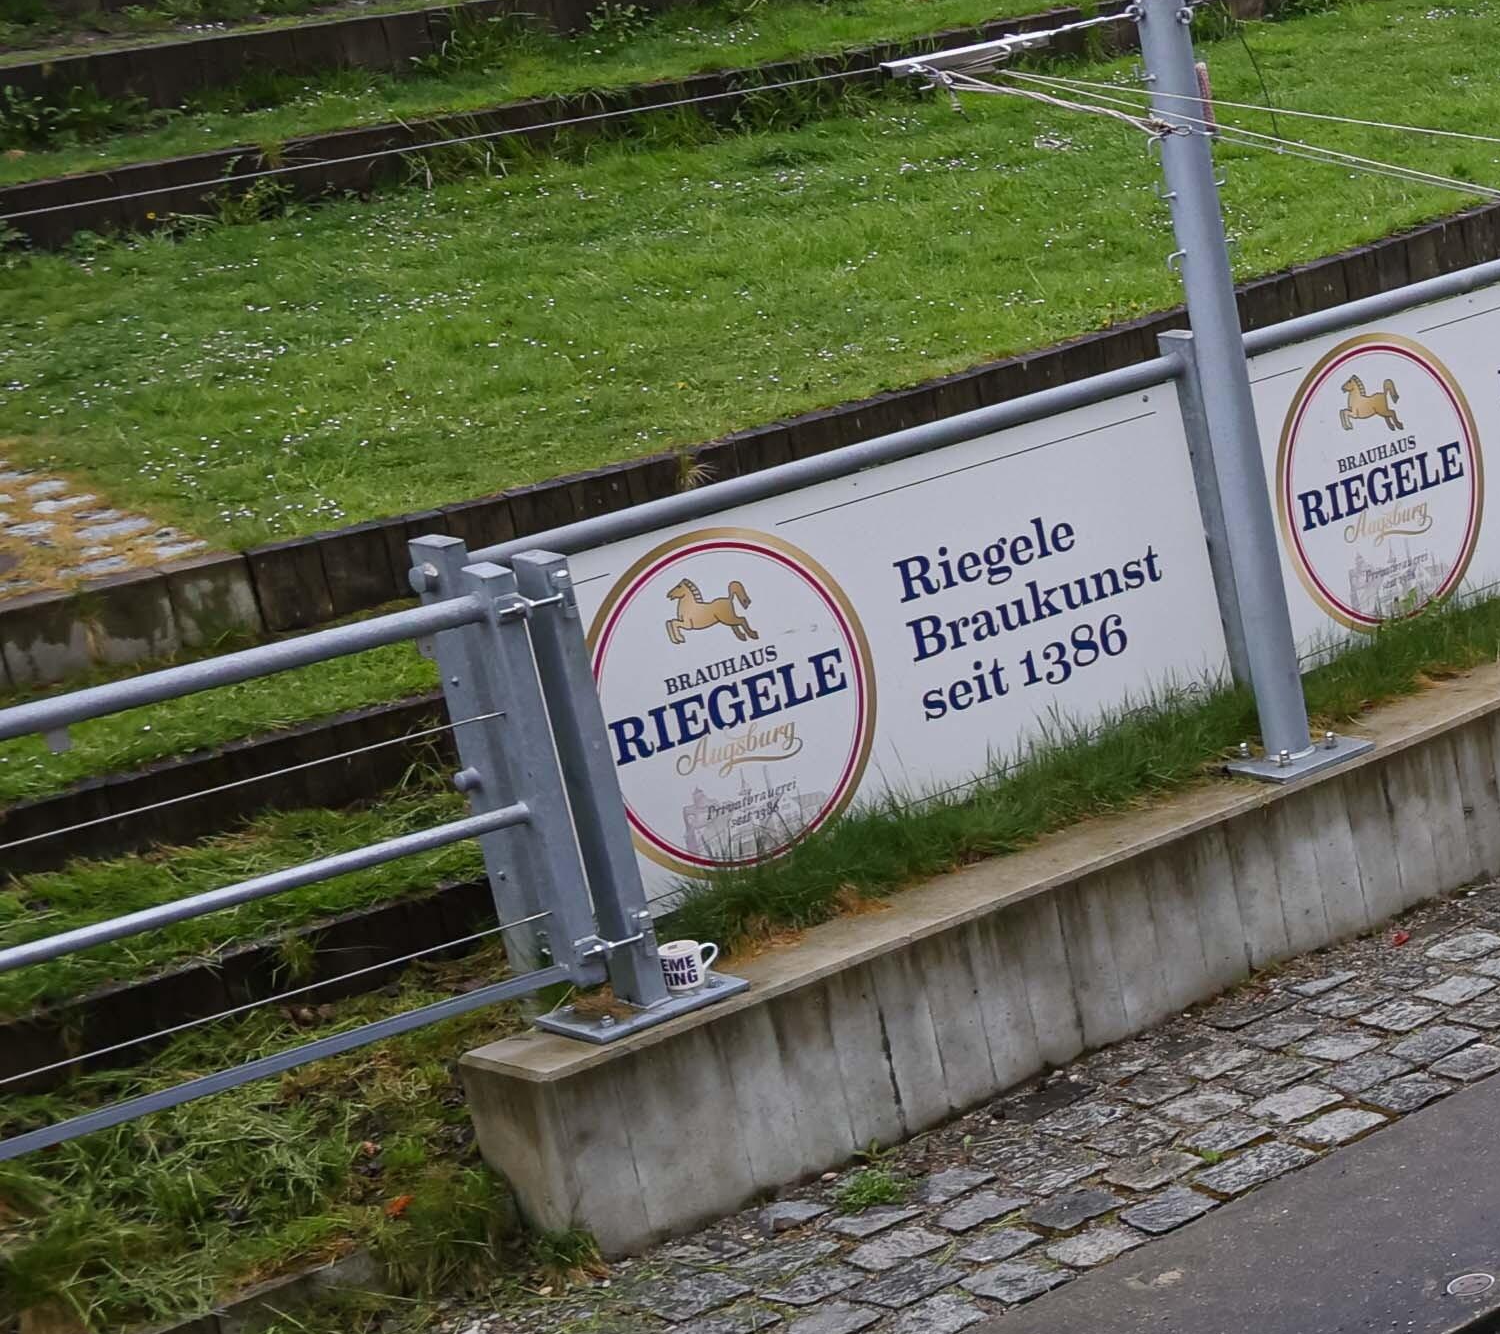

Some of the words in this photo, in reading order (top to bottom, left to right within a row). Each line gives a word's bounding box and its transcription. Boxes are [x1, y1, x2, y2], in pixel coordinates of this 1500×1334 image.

[1298, 441, 1465, 531] RIEGELE
[1337, 435, 1417, 474] BRAUHAUS
[893, 517, 1075, 604] Riegele
[1344, 500, 1433, 547] Augsburg
[906, 545, 1163, 662] Braukunst
[608, 648, 849, 766] RIEGELE
[664, 645, 778, 696] BRAUHAUS
[922, 658, 1009, 721] seit
[1019, 614, 1128, 686] 1386
[676, 718, 803, 777] Augsburg
